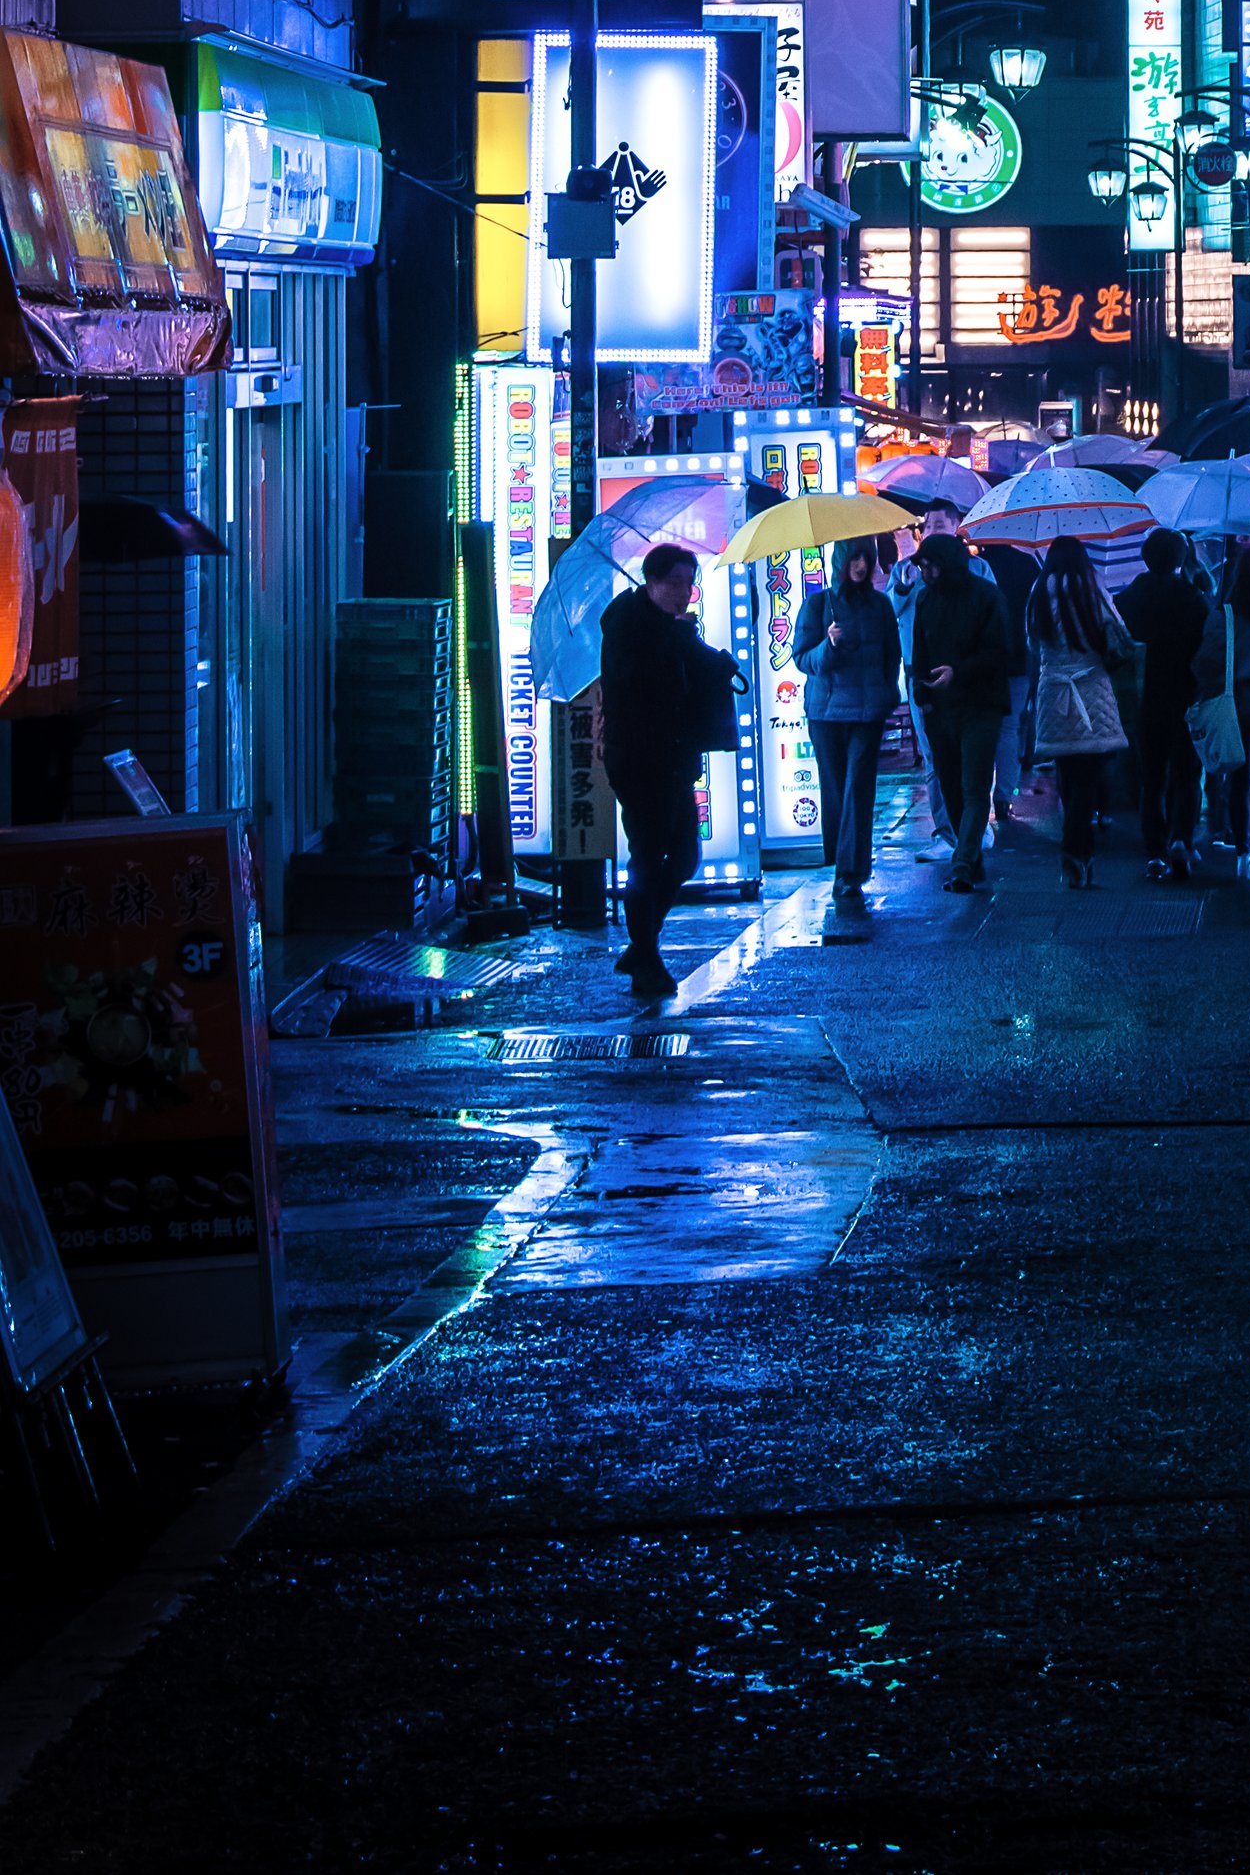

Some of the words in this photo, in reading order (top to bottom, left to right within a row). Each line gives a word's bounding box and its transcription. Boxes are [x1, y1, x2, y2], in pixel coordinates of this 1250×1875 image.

[507, 384, 536, 467] ROBOT
[507, 485, 537, 630] RESTAURANT
[508, 649, 537, 729] TICKET
[508, 733, 537, 839] COUNTER
[179, 941, 225, 974] 3F
